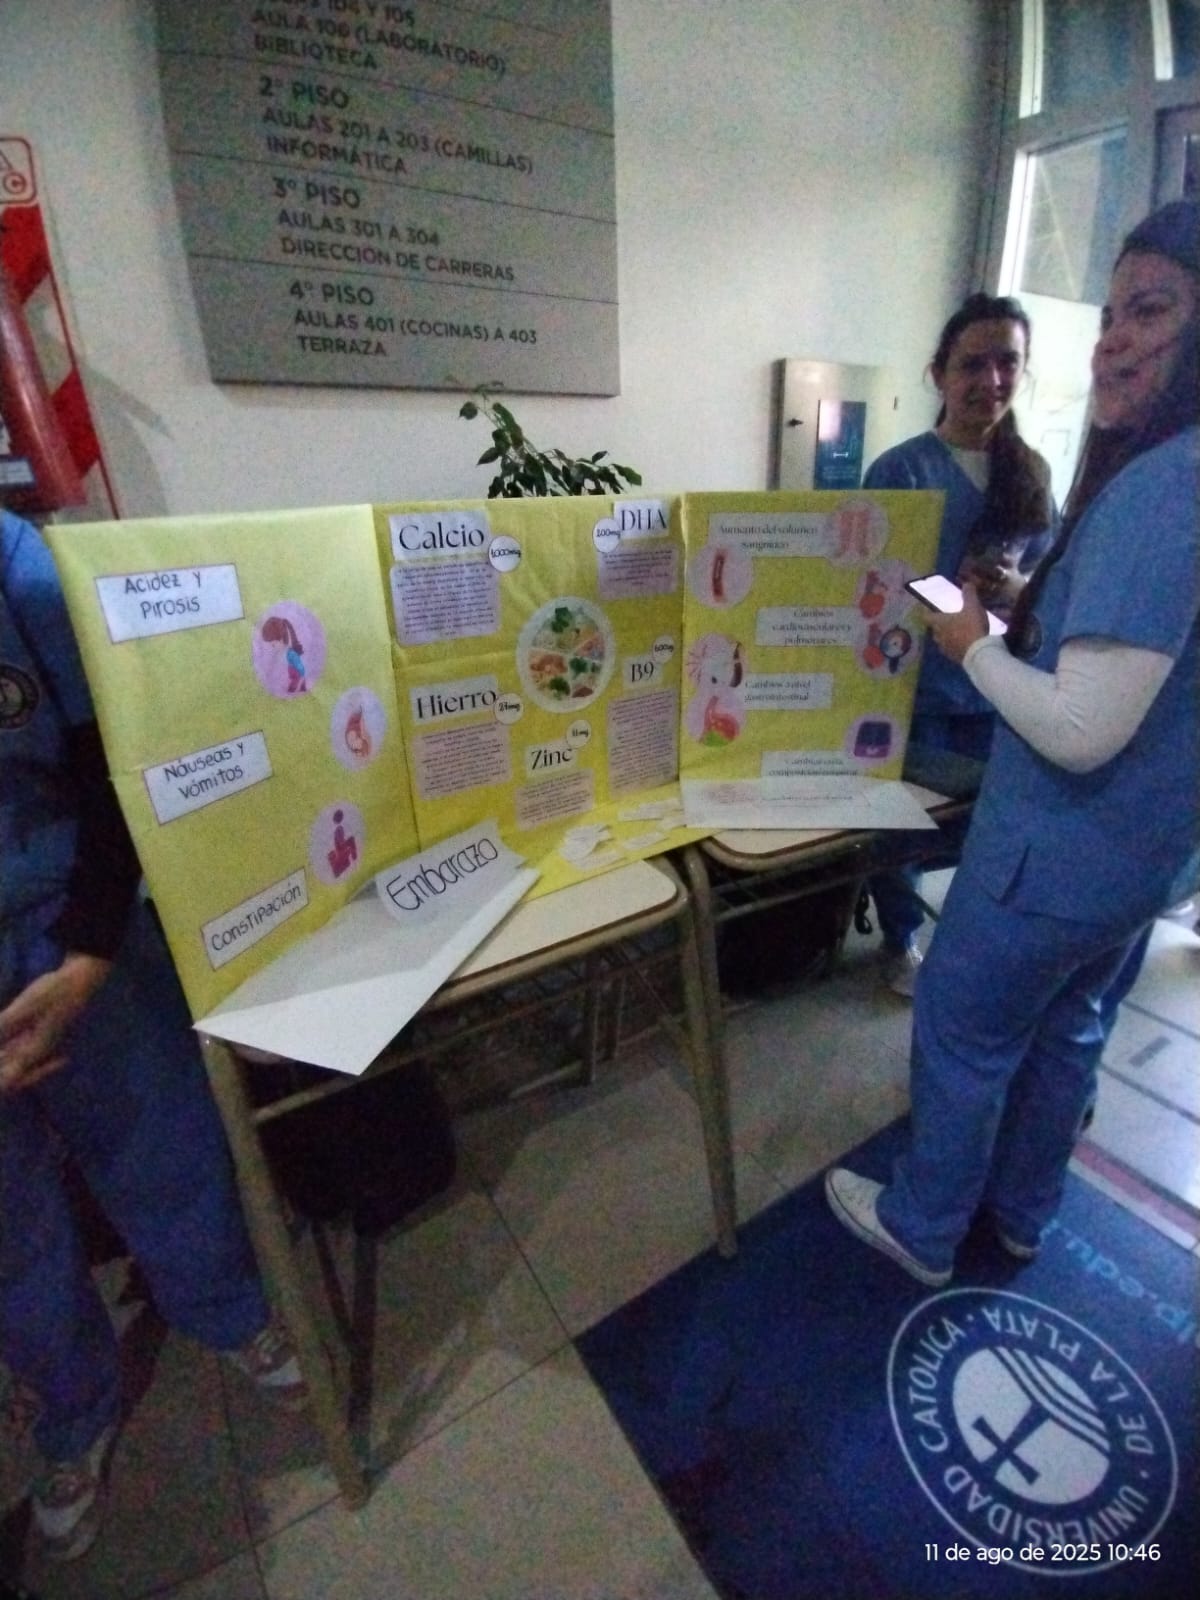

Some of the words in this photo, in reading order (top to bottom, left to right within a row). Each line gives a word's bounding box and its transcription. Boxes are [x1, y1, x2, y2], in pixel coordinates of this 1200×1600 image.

[251, 9, 310, 31] AULA
[356, 23, 506, 76] (LABORATORIO)
[254, 33, 377, 69] BIBLIOTECA
[291, 81, 349, 109] PISO
[263, 107, 333, 134] AULAS
[340, 121, 371, 140] 201
[377, 127, 390, 143] A
[396, 130, 430, 152] 203
[435, 136, 533, 175] (CAMILLAS)
[305, 181, 360, 209] PISO
[278, 209, 346, 234] AULAS
[351, 219, 382, 239] 301
[389, 225, 401, 242] A
[407, 226, 440, 246] 304
[396, 253, 420, 270] DE
[425, 256, 515, 281] CARRERAS
[321, 282, 374, 306] PISO
[294, 309, 359, 331] AULAS
[364, 316, 395, 333] 401
[400, 319, 489, 342] (COCINAS)
[494, 329, 504, 341] A
[509, 329, 537, 344] 403
[296, 335, 388, 356] TERRAZA
[621, 508, 667, 531] DHA
[399, 521, 485, 551] Calcio
[124, 572, 182, 595] Acidez
[631, 661, 655, 682] B9
[416, 690, 497, 718] Hierro
[531, 748, 572, 770] Zinc
[386, 838, 499, 911] Embarazo
[981, 1306, 1081, 1362] PLATA
[1091, 1360, 1130, 1403] LA
[1117, 1413, 1154, 1455] DE
[944, 1465, 1149, 1547] UNIVERSIDAD
